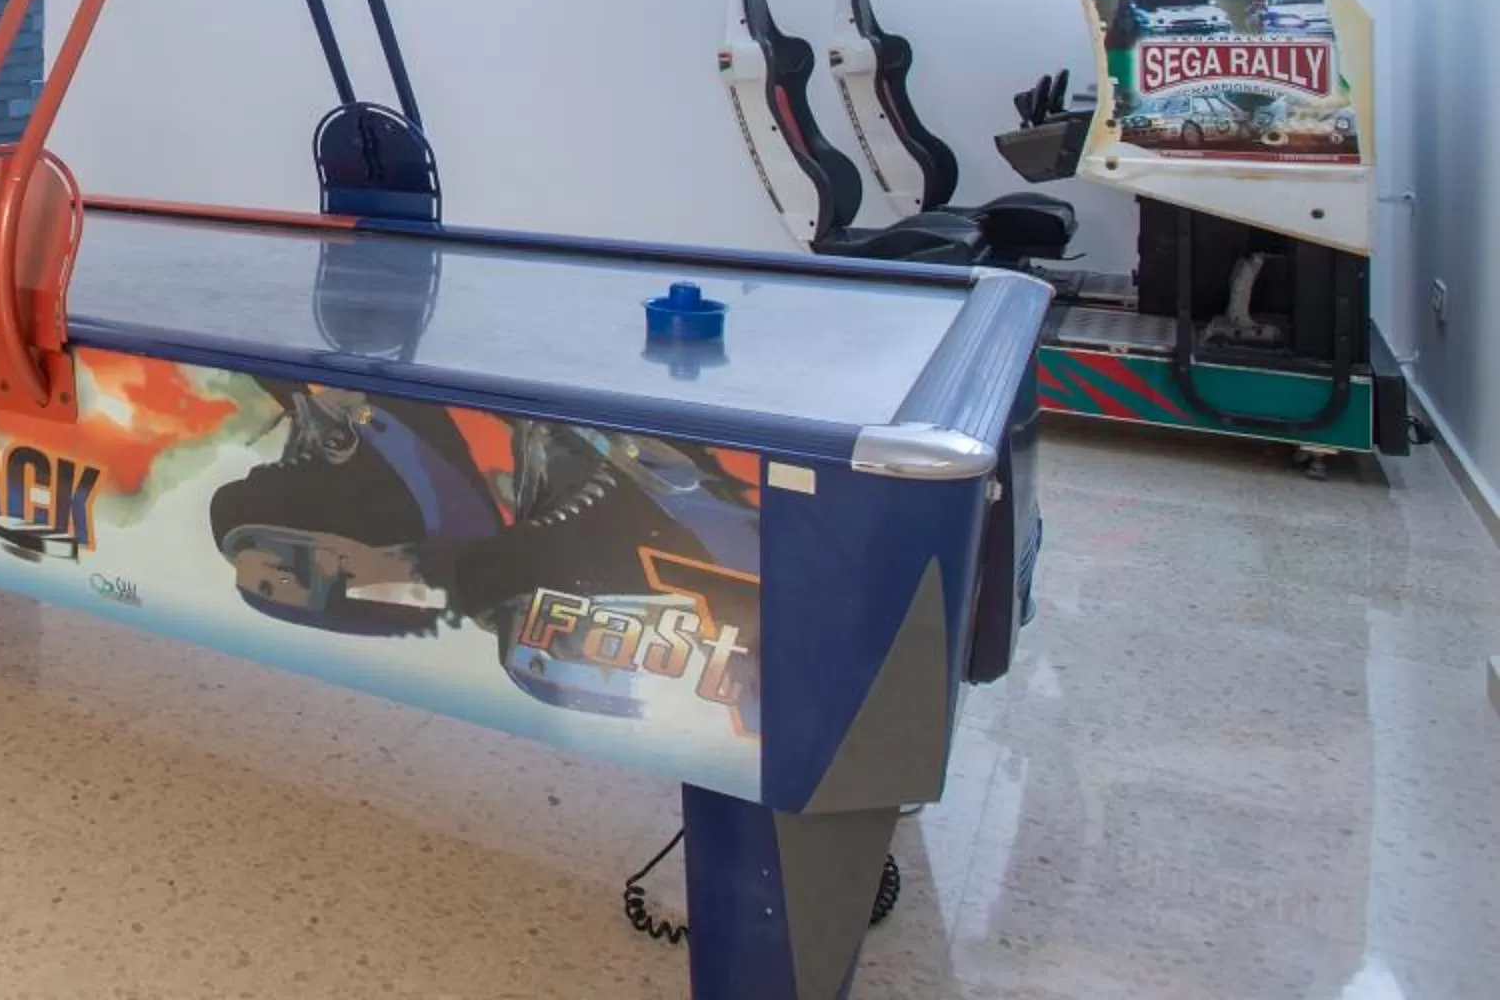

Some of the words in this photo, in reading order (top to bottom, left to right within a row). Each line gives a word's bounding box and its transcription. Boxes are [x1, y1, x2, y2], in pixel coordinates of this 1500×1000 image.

[1145, 47, 1222, 88] SEGA
[1229, 47, 1325, 89] RALLY
[517, 587, 749, 706] Fast
